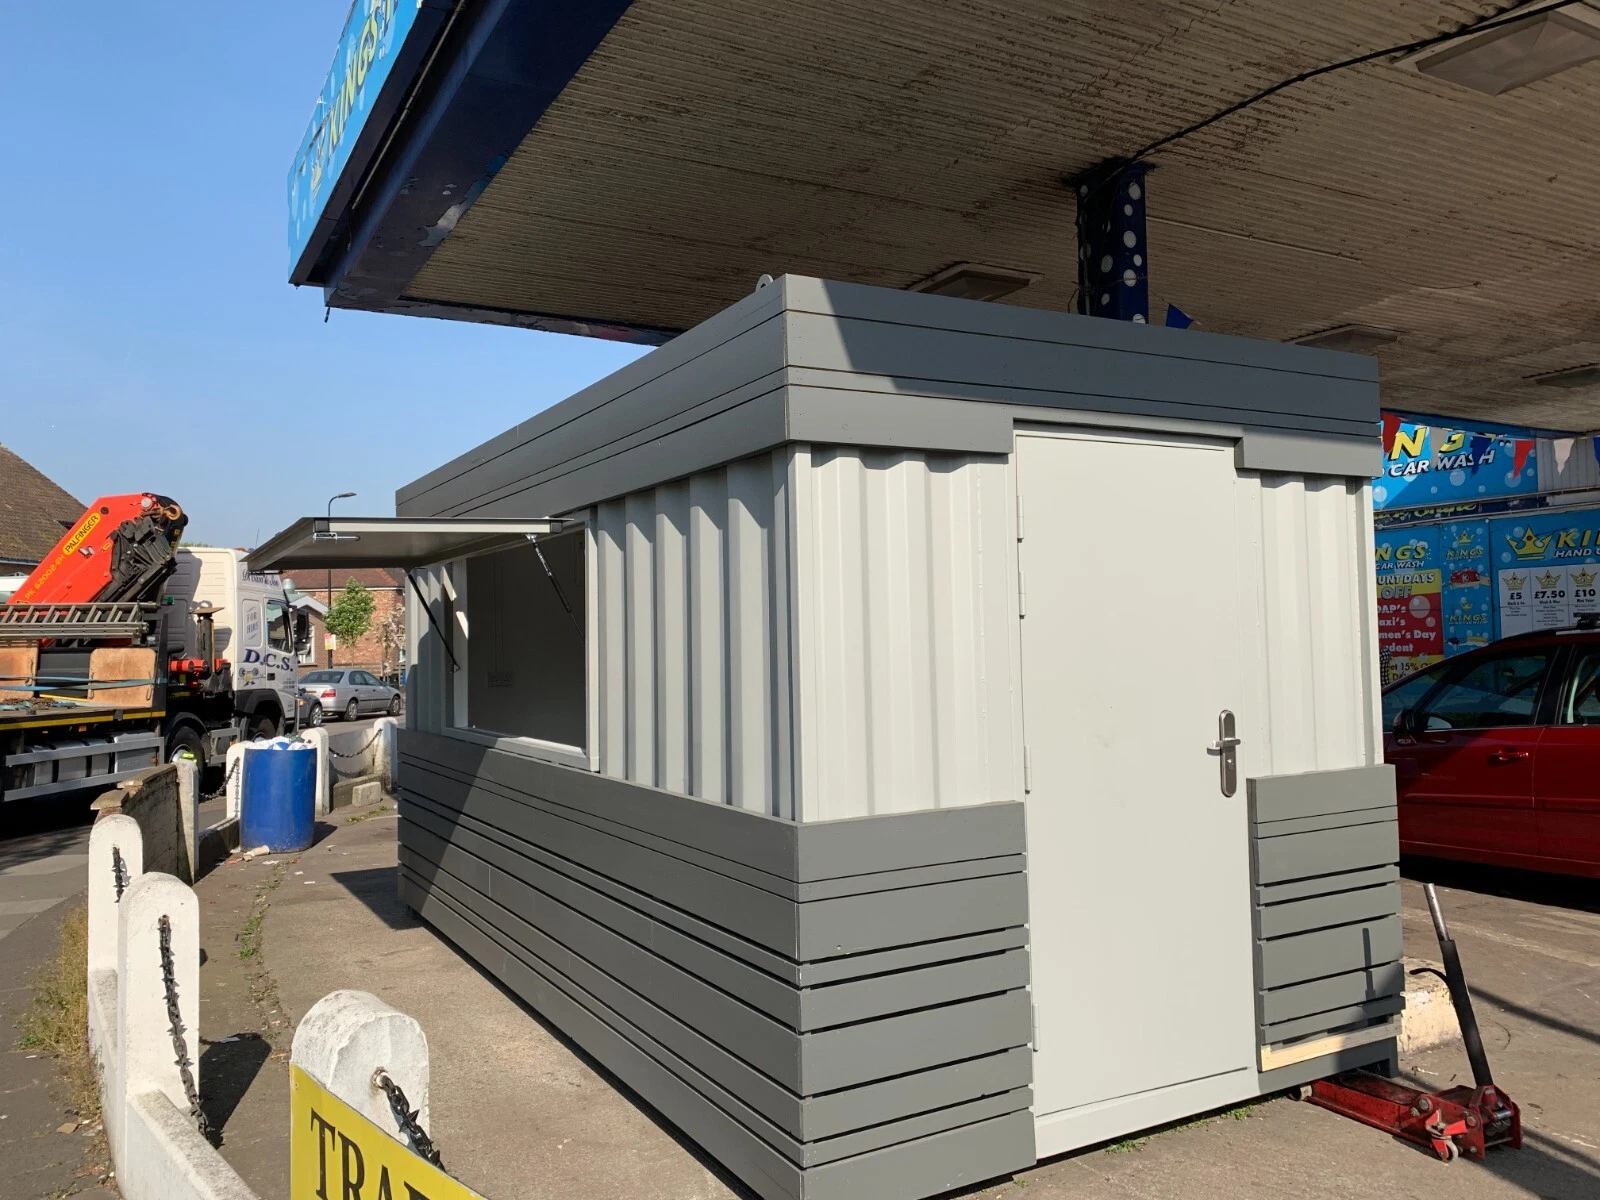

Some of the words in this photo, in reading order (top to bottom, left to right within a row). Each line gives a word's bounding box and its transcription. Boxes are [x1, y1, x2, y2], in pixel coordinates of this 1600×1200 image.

[1390, 459, 1430, 476] CAR
[65, 514, 99, 553] PALFINGER
[1555, 548, 1592, 558] HAND
[1396, 560, 1425, 569] WASH
[1403, 572, 1435, 584] DAYS
[1381, 586, 1412, 599] OFF
[1510, 592, 1523, 600] £5
[1534, 590, 1566, 599] £7.50
[1574, 588, 1596, 598] £10
[1413, 630, 1436, 641] Day
[1400, 662, 1418, 671] 15%
